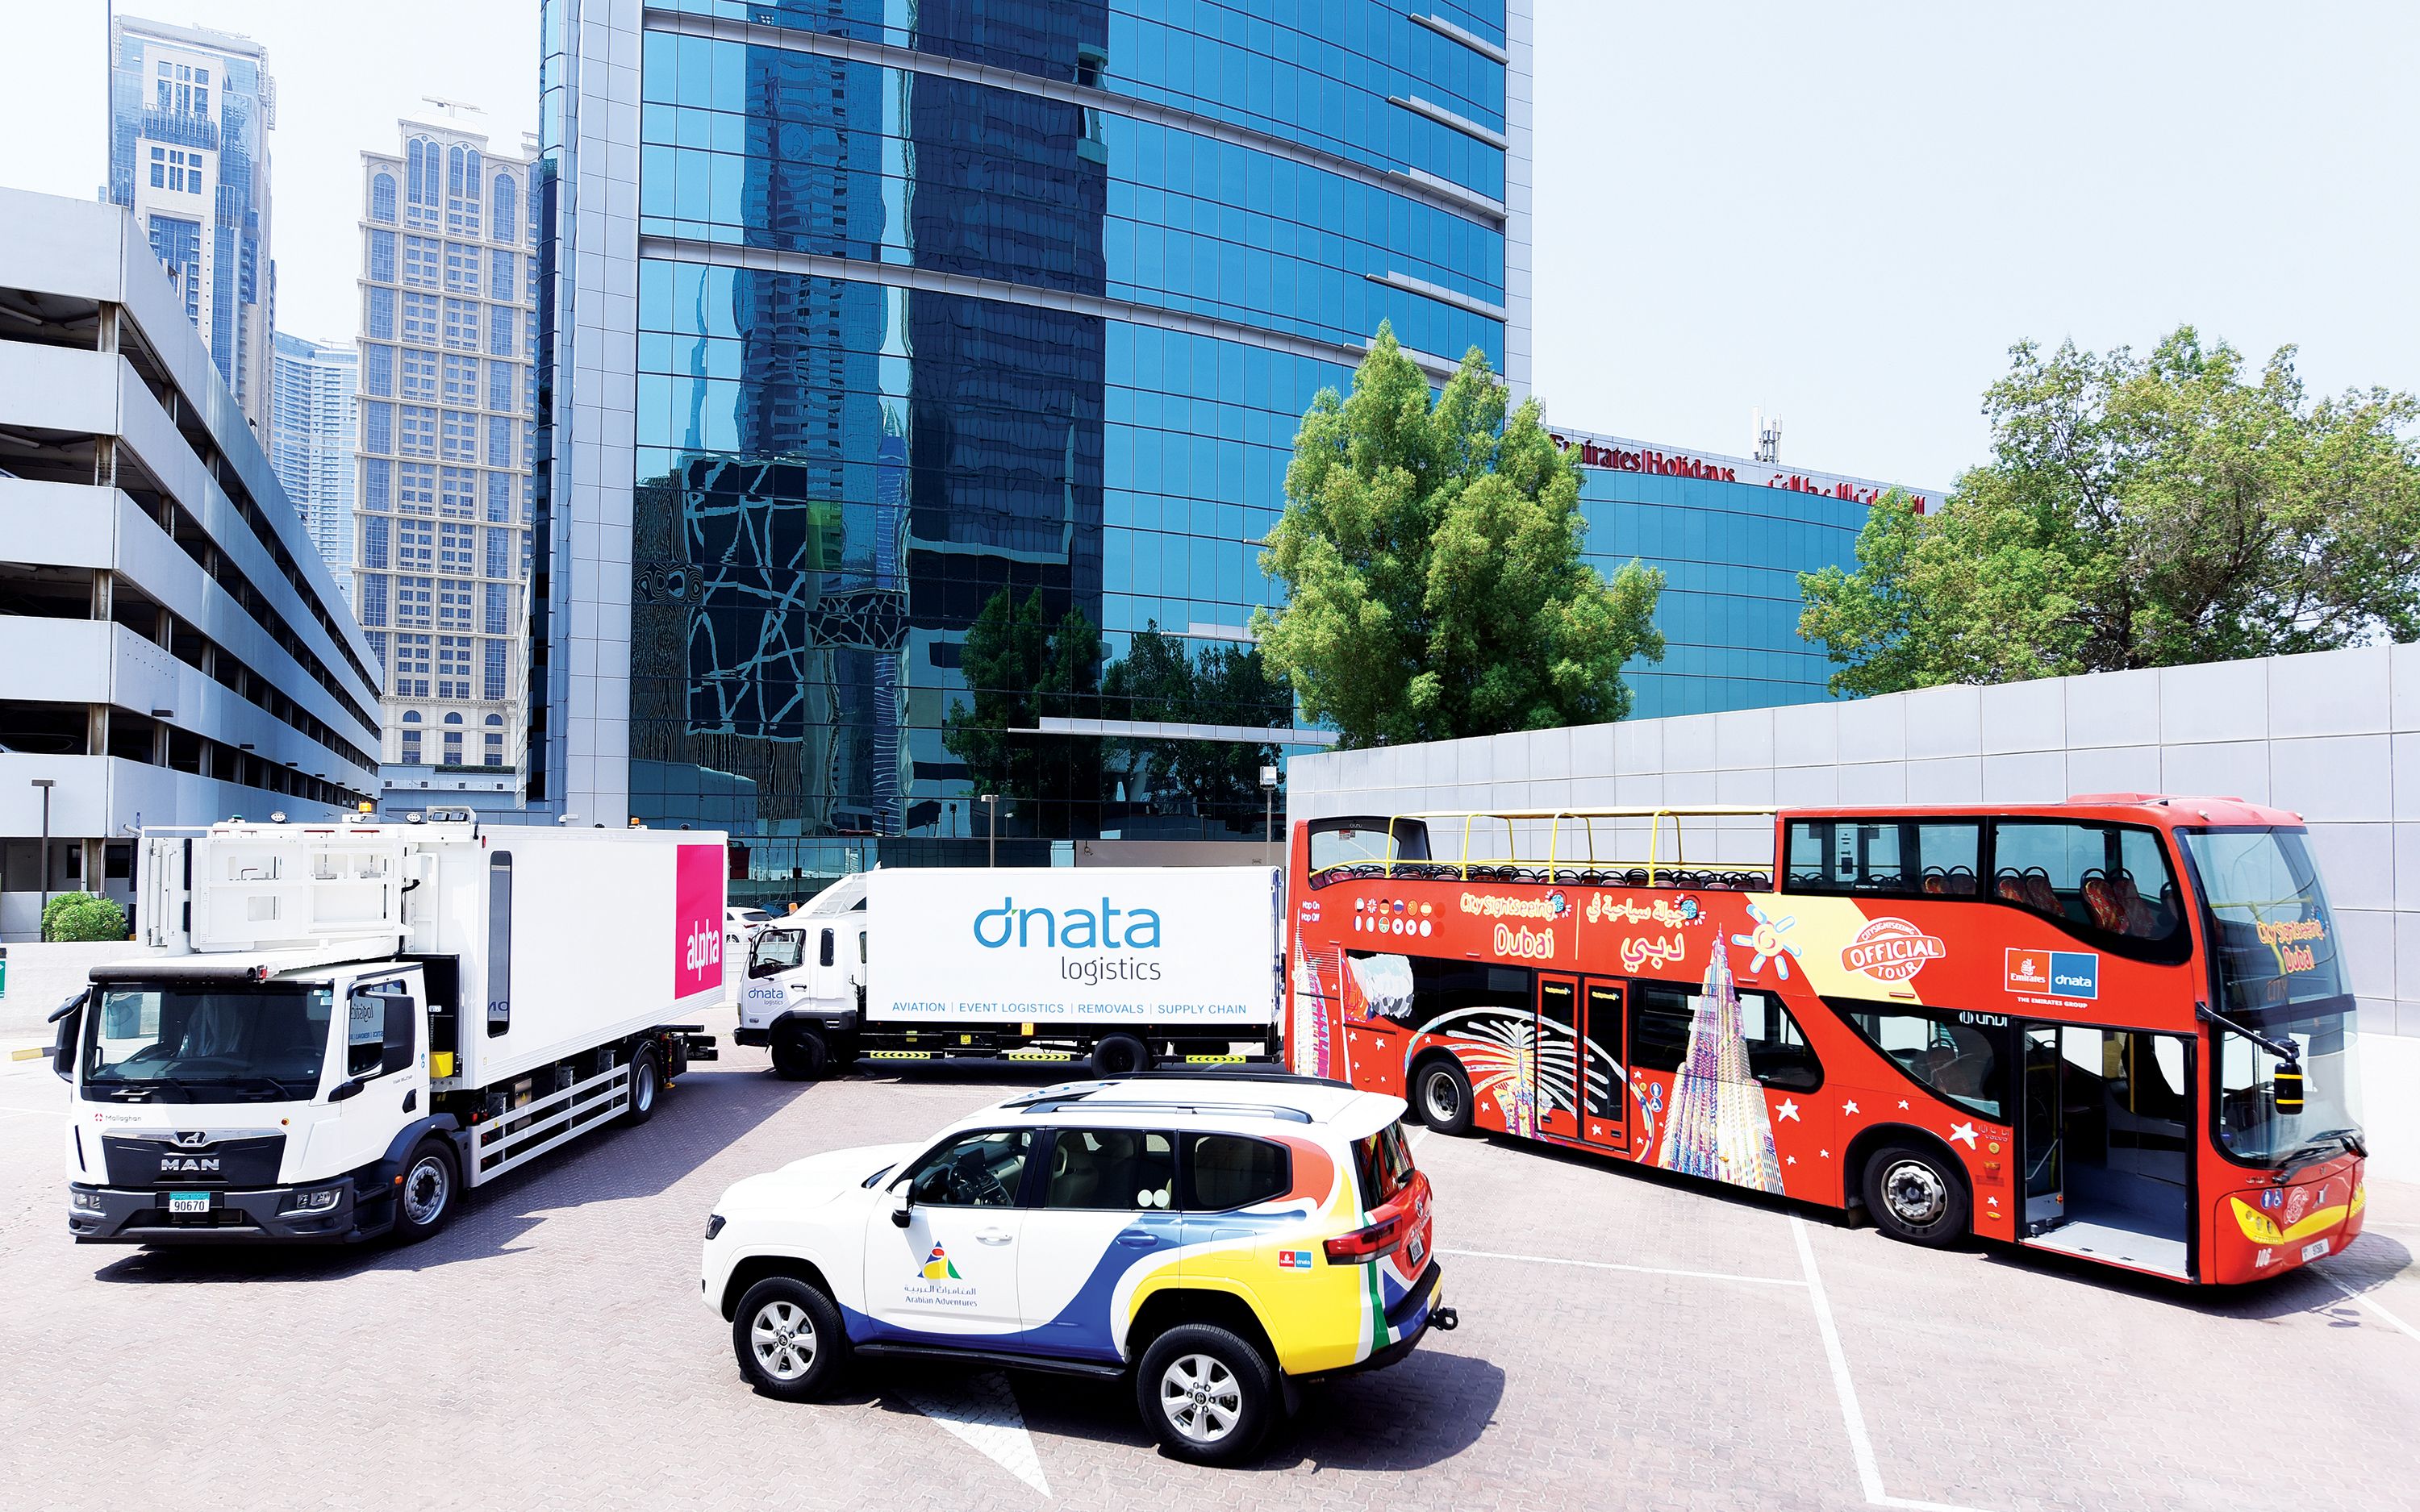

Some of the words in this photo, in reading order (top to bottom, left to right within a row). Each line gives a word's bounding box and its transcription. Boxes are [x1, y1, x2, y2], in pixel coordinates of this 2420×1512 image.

[1550, 433, 1641, 472] Eirates
[1586, 891, 1601, 923] في
[1602, 894, 1651, 924] سياحية
[1652, 899, 1688, 928] جولة
[974, 897, 1160, 948] dnata
[686, 918, 720, 981] alpha
[1494, 923, 1554, 959] Dubai
[1621, 932, 1685, 973] دبي
[1850, 939, 1939, 968] OFFICIAL
[2282, 944, 2315, 973] Dubai
[1061, 956, 1162, 985] logistics
[1877, 961, 1917, 979] TOUR
[2009, 973, 2046, 983] Emirates
[2055, 974, 2092, 988] dnata
[748, 988, 783, 999] dnata
[2031, 998, 2063, 1006] EMIRATES
[892, 1002, 945, 1012] AVIATION
[959, 1002, 997, 1012] EVENT
[1002, 1003, 1064, 1013] LOGISTICS
[1079, 1004, 1144, 1014] REMOVALS
[1158, 1005, 1204, 1014] SUPPLY
[1208, 1005, 1246, 1014] CHAIN
[106, 1114, 142, 1123] Mallaghan
[161, 1159, 219, 1171] MAN
[174, 1201, 205, 1211] 90670
[2255, 1248, 2272, 1268] 106
[905, 1296, 933, 1305] Arabian
[935, 1297, 978, 1307] Adventures
